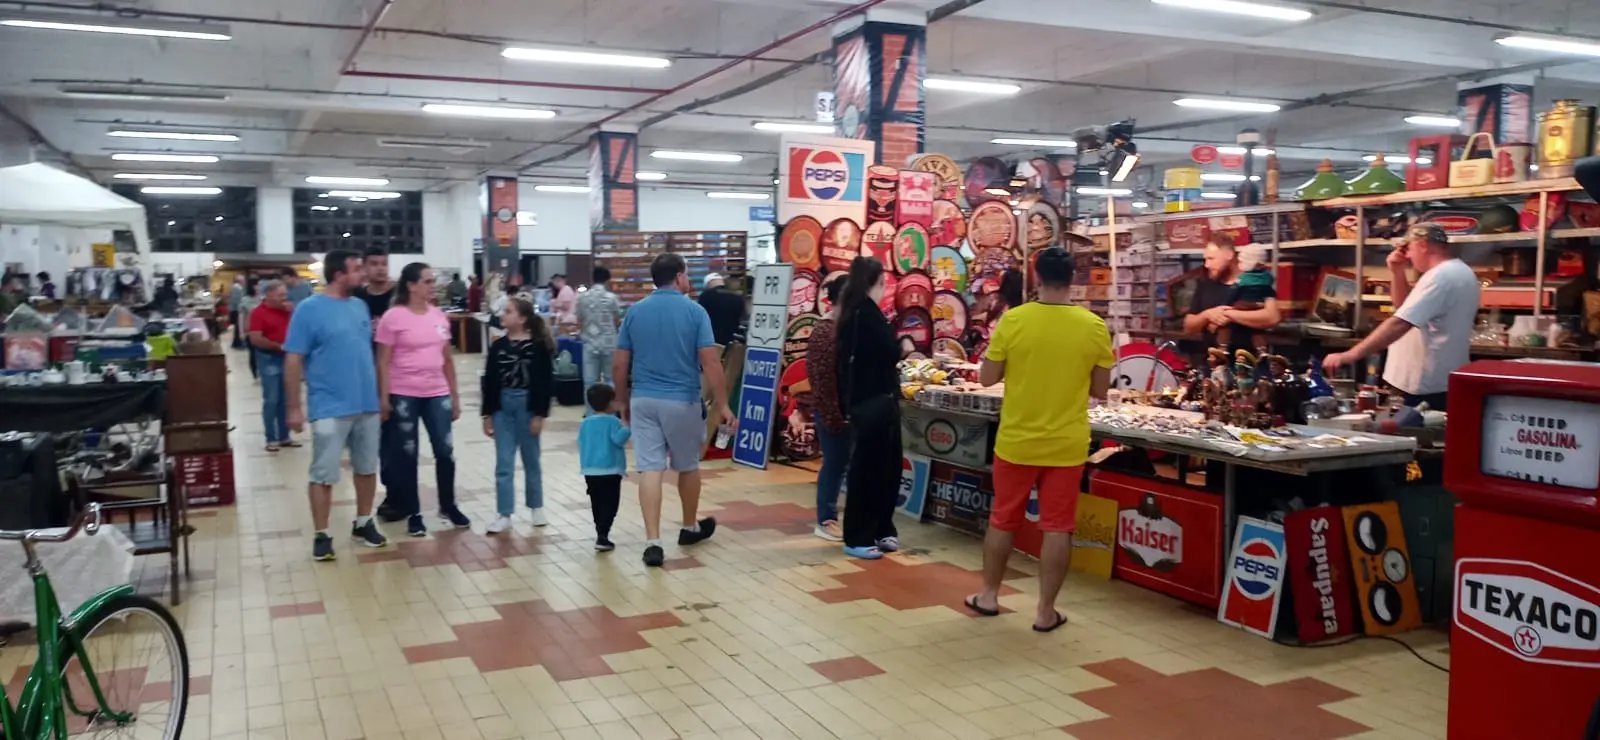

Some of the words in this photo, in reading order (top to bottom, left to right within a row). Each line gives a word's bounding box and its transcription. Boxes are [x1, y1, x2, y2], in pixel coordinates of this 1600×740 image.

[805, 167, 846, 182] PEPSI
[764, 276, 780, 294] PR
[755, 313, 767, 328] BR
[768, 314, 780, 329] 116
[747, 361, 776, 378] NORTE
[745, 400, 765, 422] km
[739, 430, 763, 452] 210
[1517, 428, 1577, 450] GASOLINA
[1121, 516, 1179, 554] Kaiser
[1234, 556, 1279, 581] PEPSI
[1309, 517, 1338, 634] Sapupara
[1465, 579, 1597, 641] TEXACO
